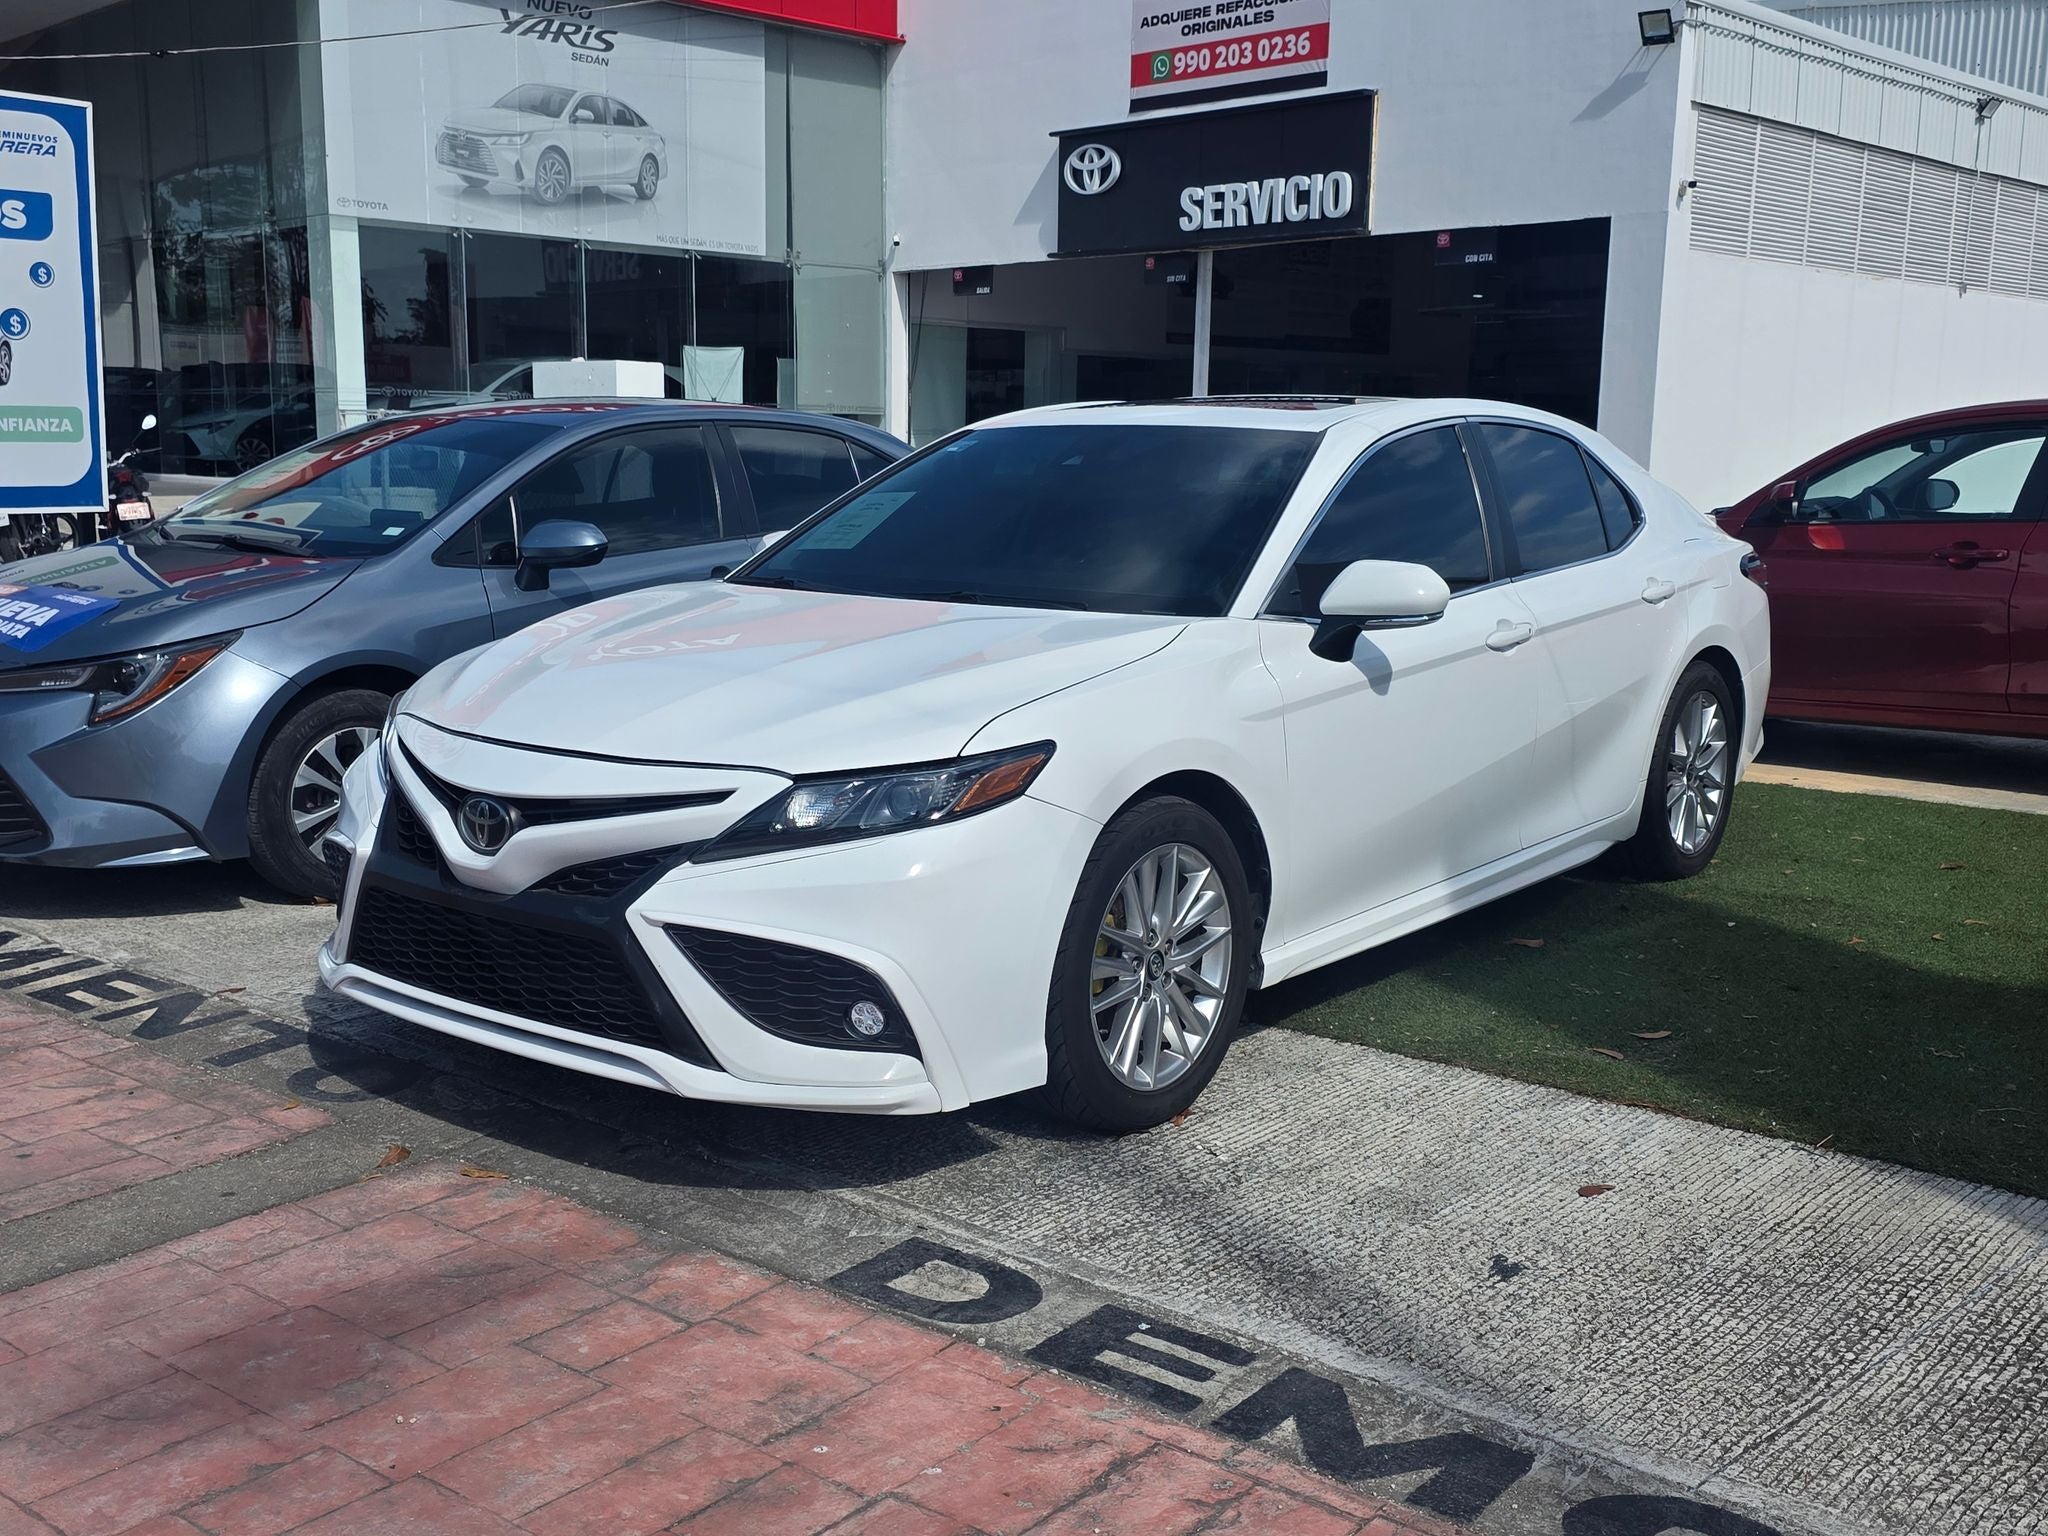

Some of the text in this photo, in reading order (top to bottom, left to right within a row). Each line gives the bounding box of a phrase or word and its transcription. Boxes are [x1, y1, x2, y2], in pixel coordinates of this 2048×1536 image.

[517, 0, 593, 20] NUEVO
[1140, 5, 1212, 29] ADQUIERE
[1181, 9, 1275, 37] ORIGINALES
[570, 51, 610, 67] SEDÁN
[1173, 31, 1311, 76] 990 203 0236
[0, 130, 58, 144] MINUEVOS
[351, 199, 389, 211] TOYOTA
[1178, 170, 1353, 232] SERVICIO
[1478, 253, 1493, 262] CITA
[396, 387, 430, 398] TOYOTA
